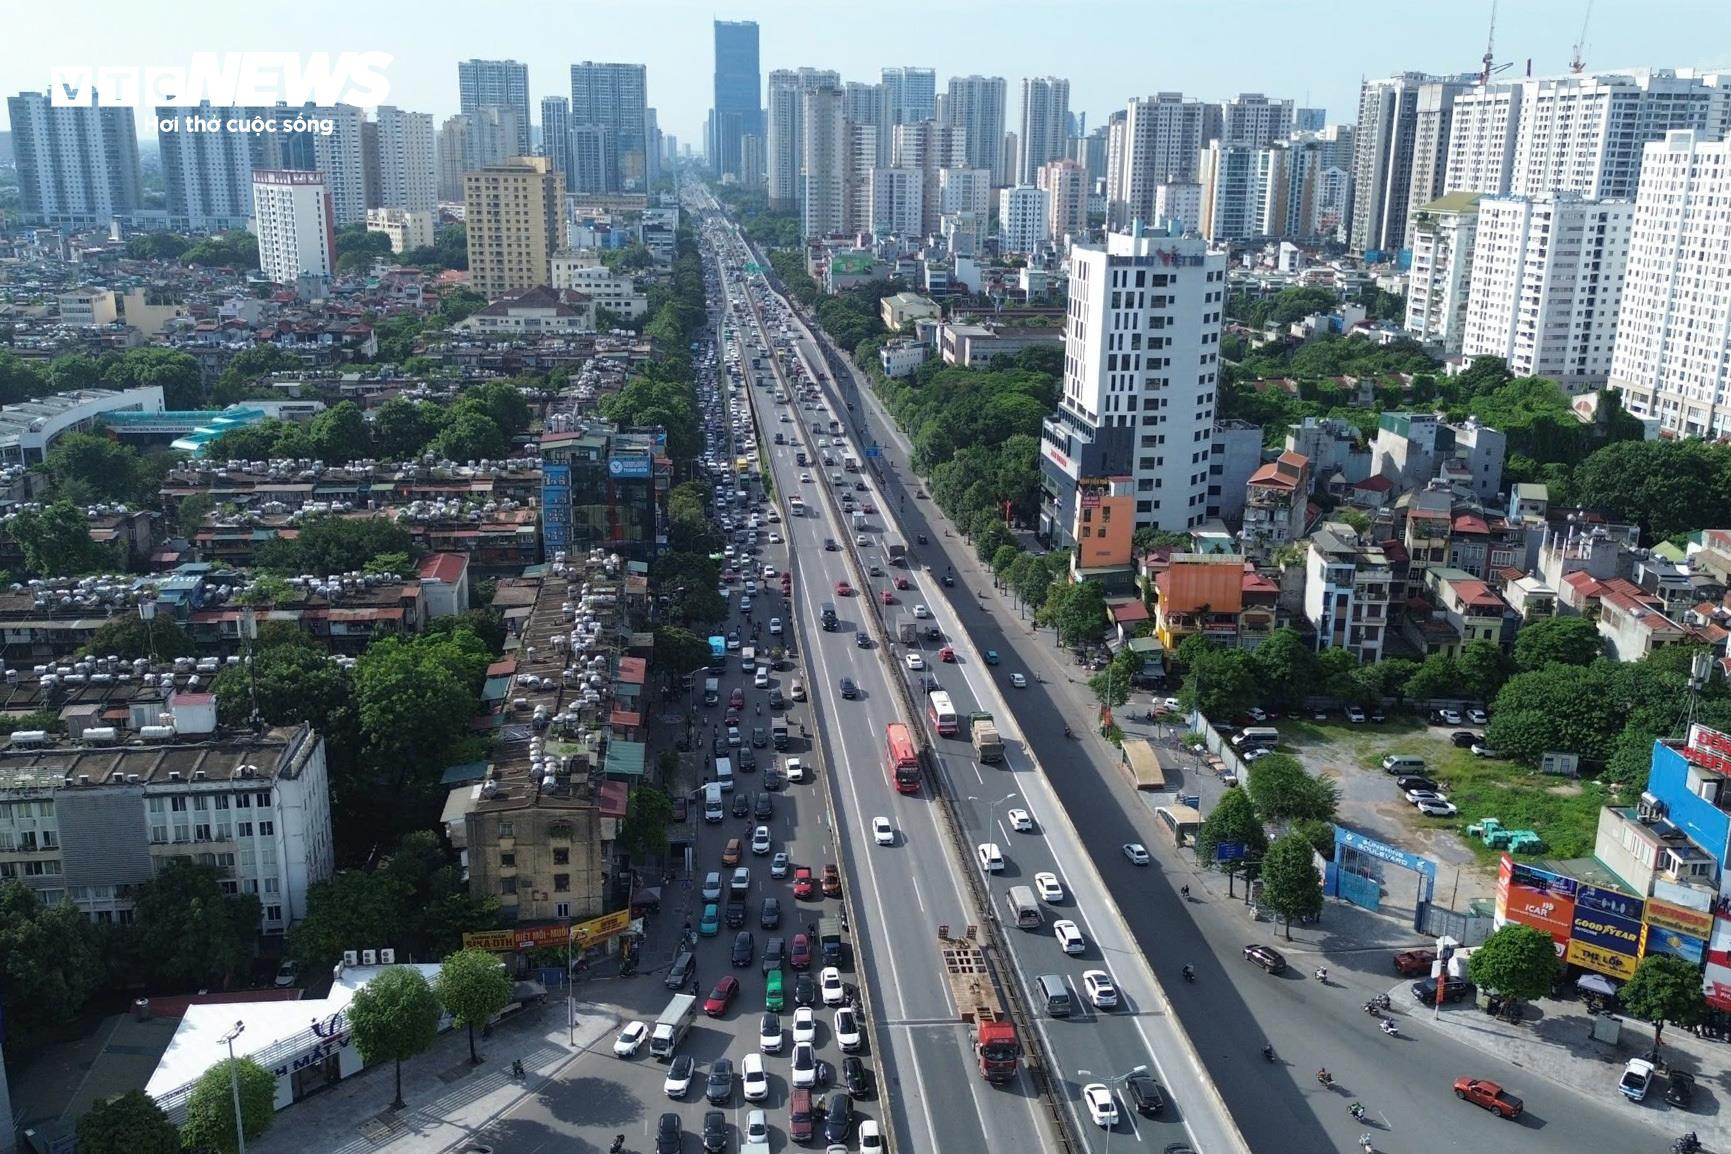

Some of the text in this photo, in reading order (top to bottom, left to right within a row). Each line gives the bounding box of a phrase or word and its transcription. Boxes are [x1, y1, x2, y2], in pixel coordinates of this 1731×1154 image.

[1357, 844, 1408, 866] BOULEVARD
[1362, 839, 1404, 858] SUNSHINE
[1525, 904, 1549, 917] ICAR
[1574, 918, 1638, 942] GOODYEAR
